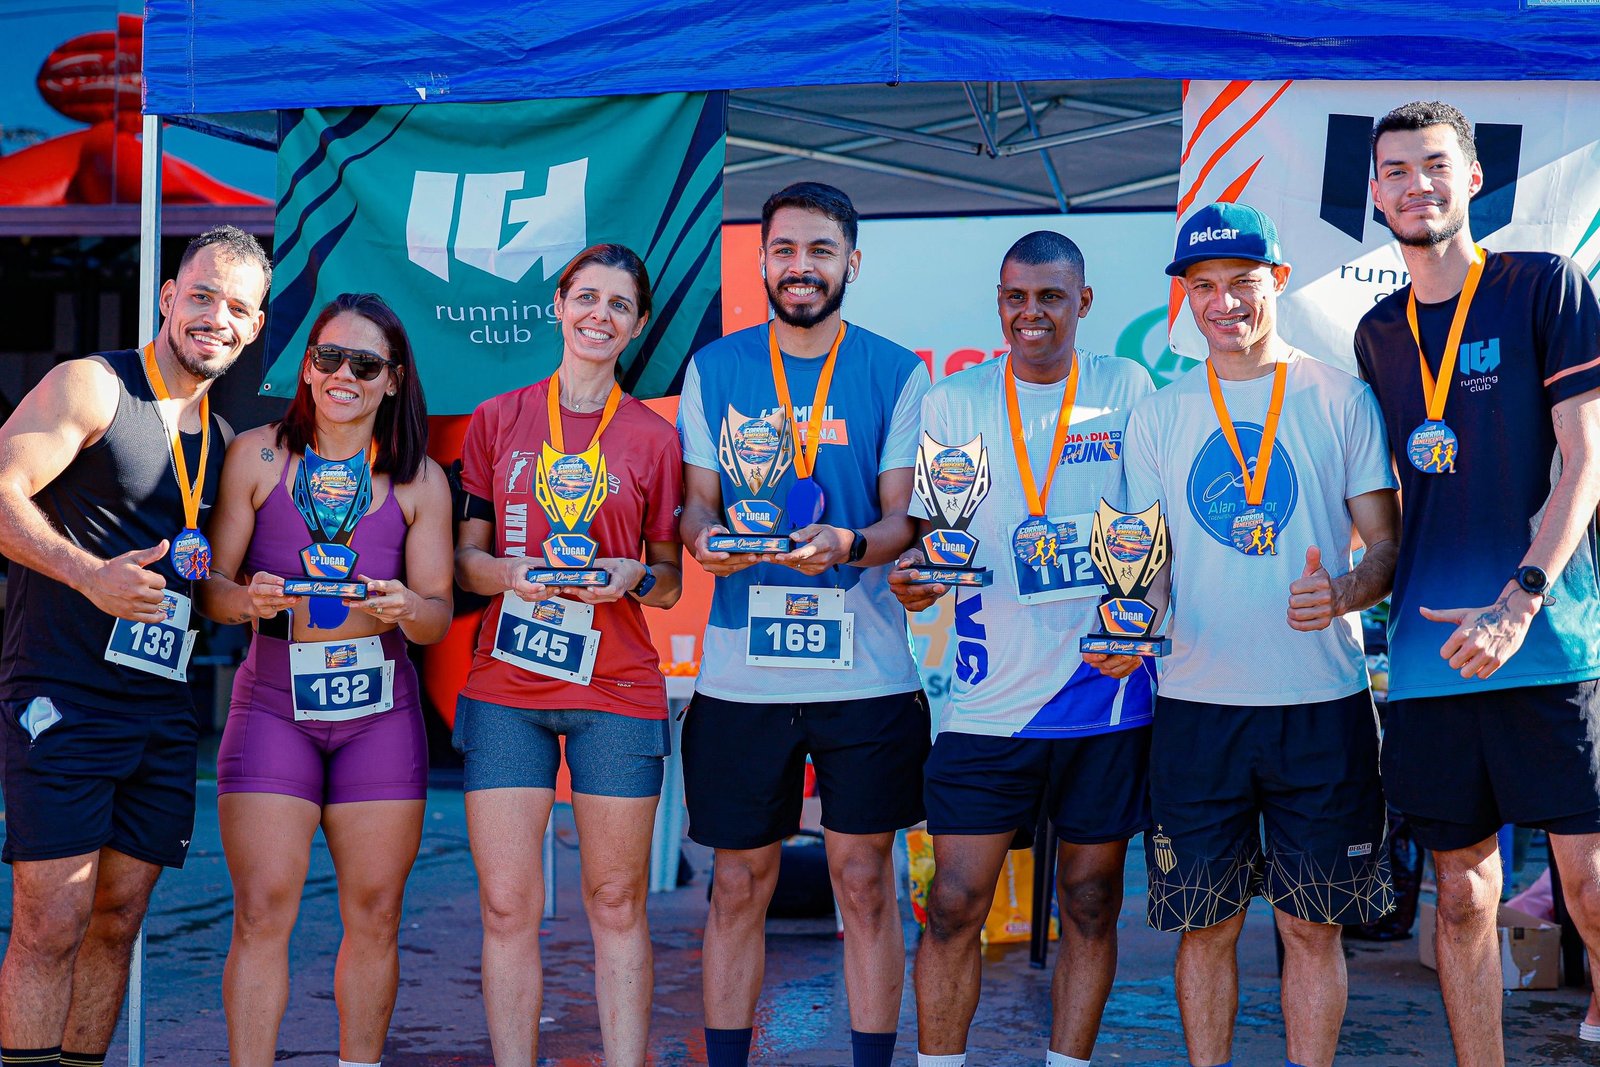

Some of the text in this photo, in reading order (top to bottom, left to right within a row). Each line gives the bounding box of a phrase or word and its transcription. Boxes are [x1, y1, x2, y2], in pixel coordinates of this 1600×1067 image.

[1189, 226, 1240, 246] Belcar
[469, 325, 532, 344] club
[1460, 375, 1499, 387] running
[1469, 382, 1492, 393] club
[1090, 432, 1109, 441] DIA
[1060, 442, 1102, 465] RUN
[1208, 501, 1236, 514] Alan
[505, 503, 528, 543] ILHA
[746, 512, 770, 521] LUGAR
[561, 546, 586, 556] LUGAR
[941, 542, 966, 553] LUGAR
[320, 556, 345, 566] LUGAR
[1119, 611, 1144, 622] LUGAR
[130, 621, 176, 660] 133
[513, 623, 570, 663] 145
[765, 622, 826, 653] 169
[310, 674, 370, 706] 132
